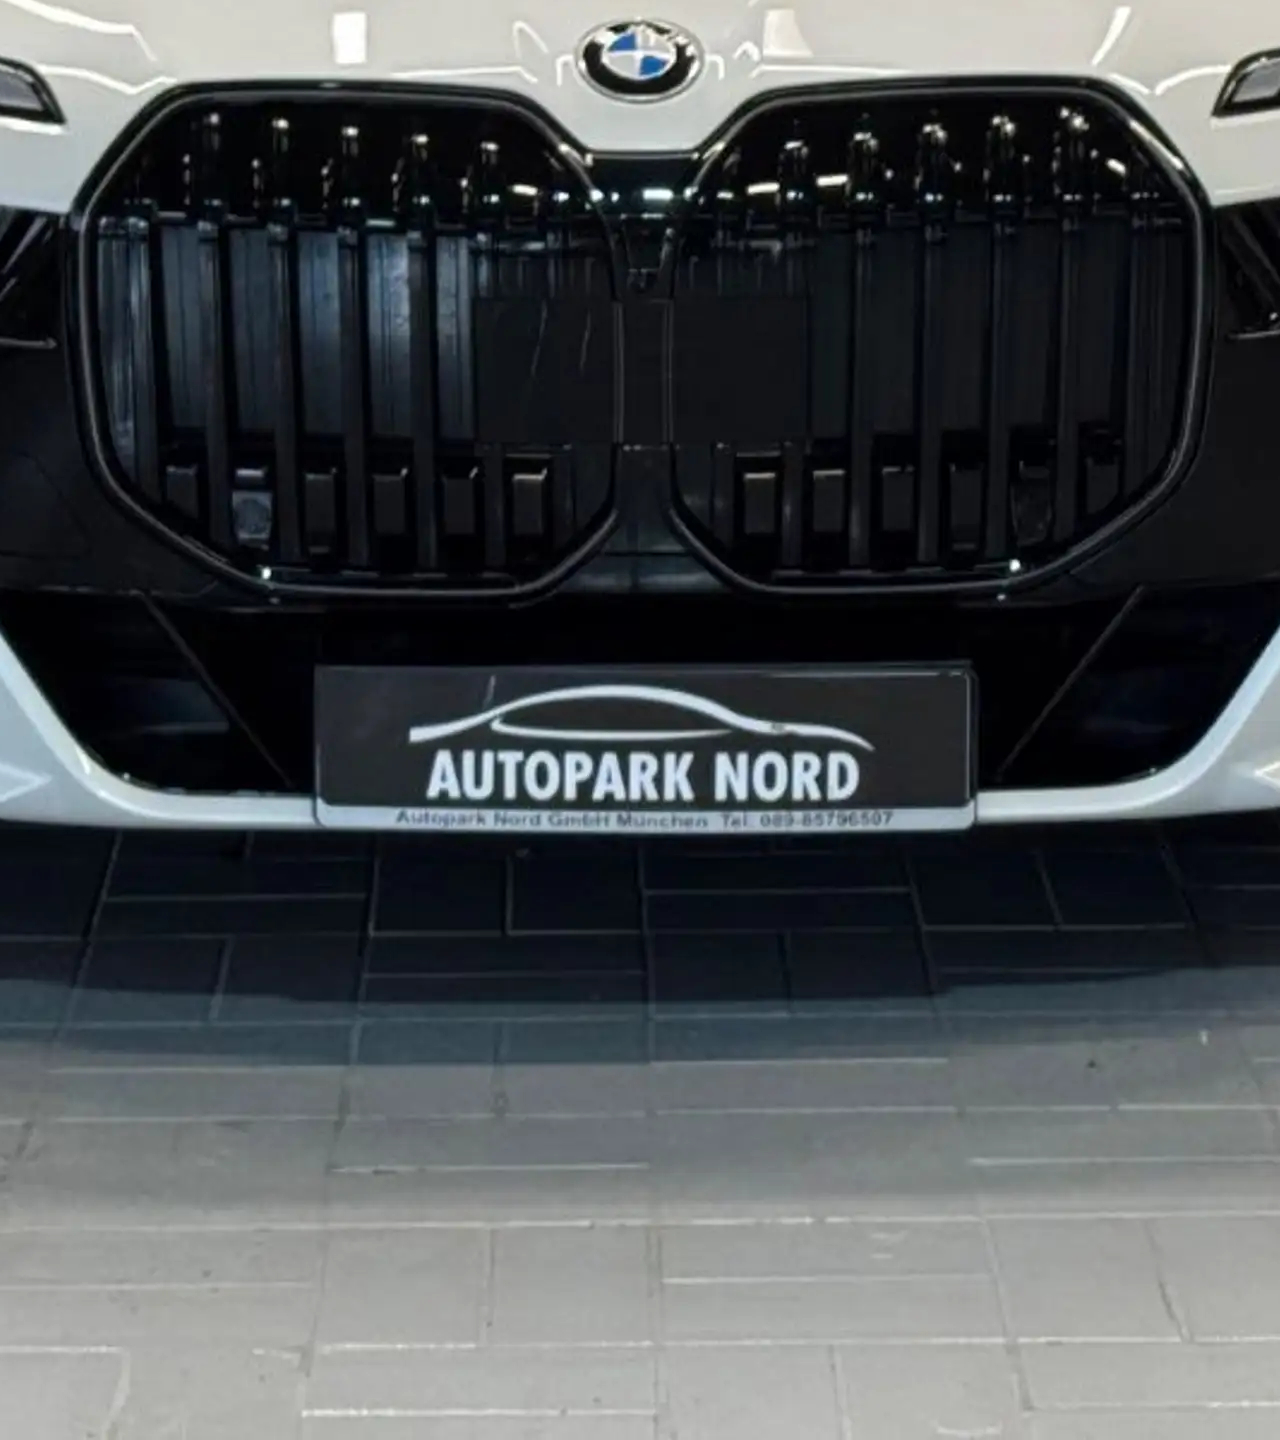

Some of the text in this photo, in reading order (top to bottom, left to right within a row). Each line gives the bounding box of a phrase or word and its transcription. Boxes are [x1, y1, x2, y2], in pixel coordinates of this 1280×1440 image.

[427, 750, 860, 802] AUTOPARK NORD
[396, 810, 486, 830] Autopark
[493, 812, 541, 828] Nord
[548, 812, 609, 829] GmbH
